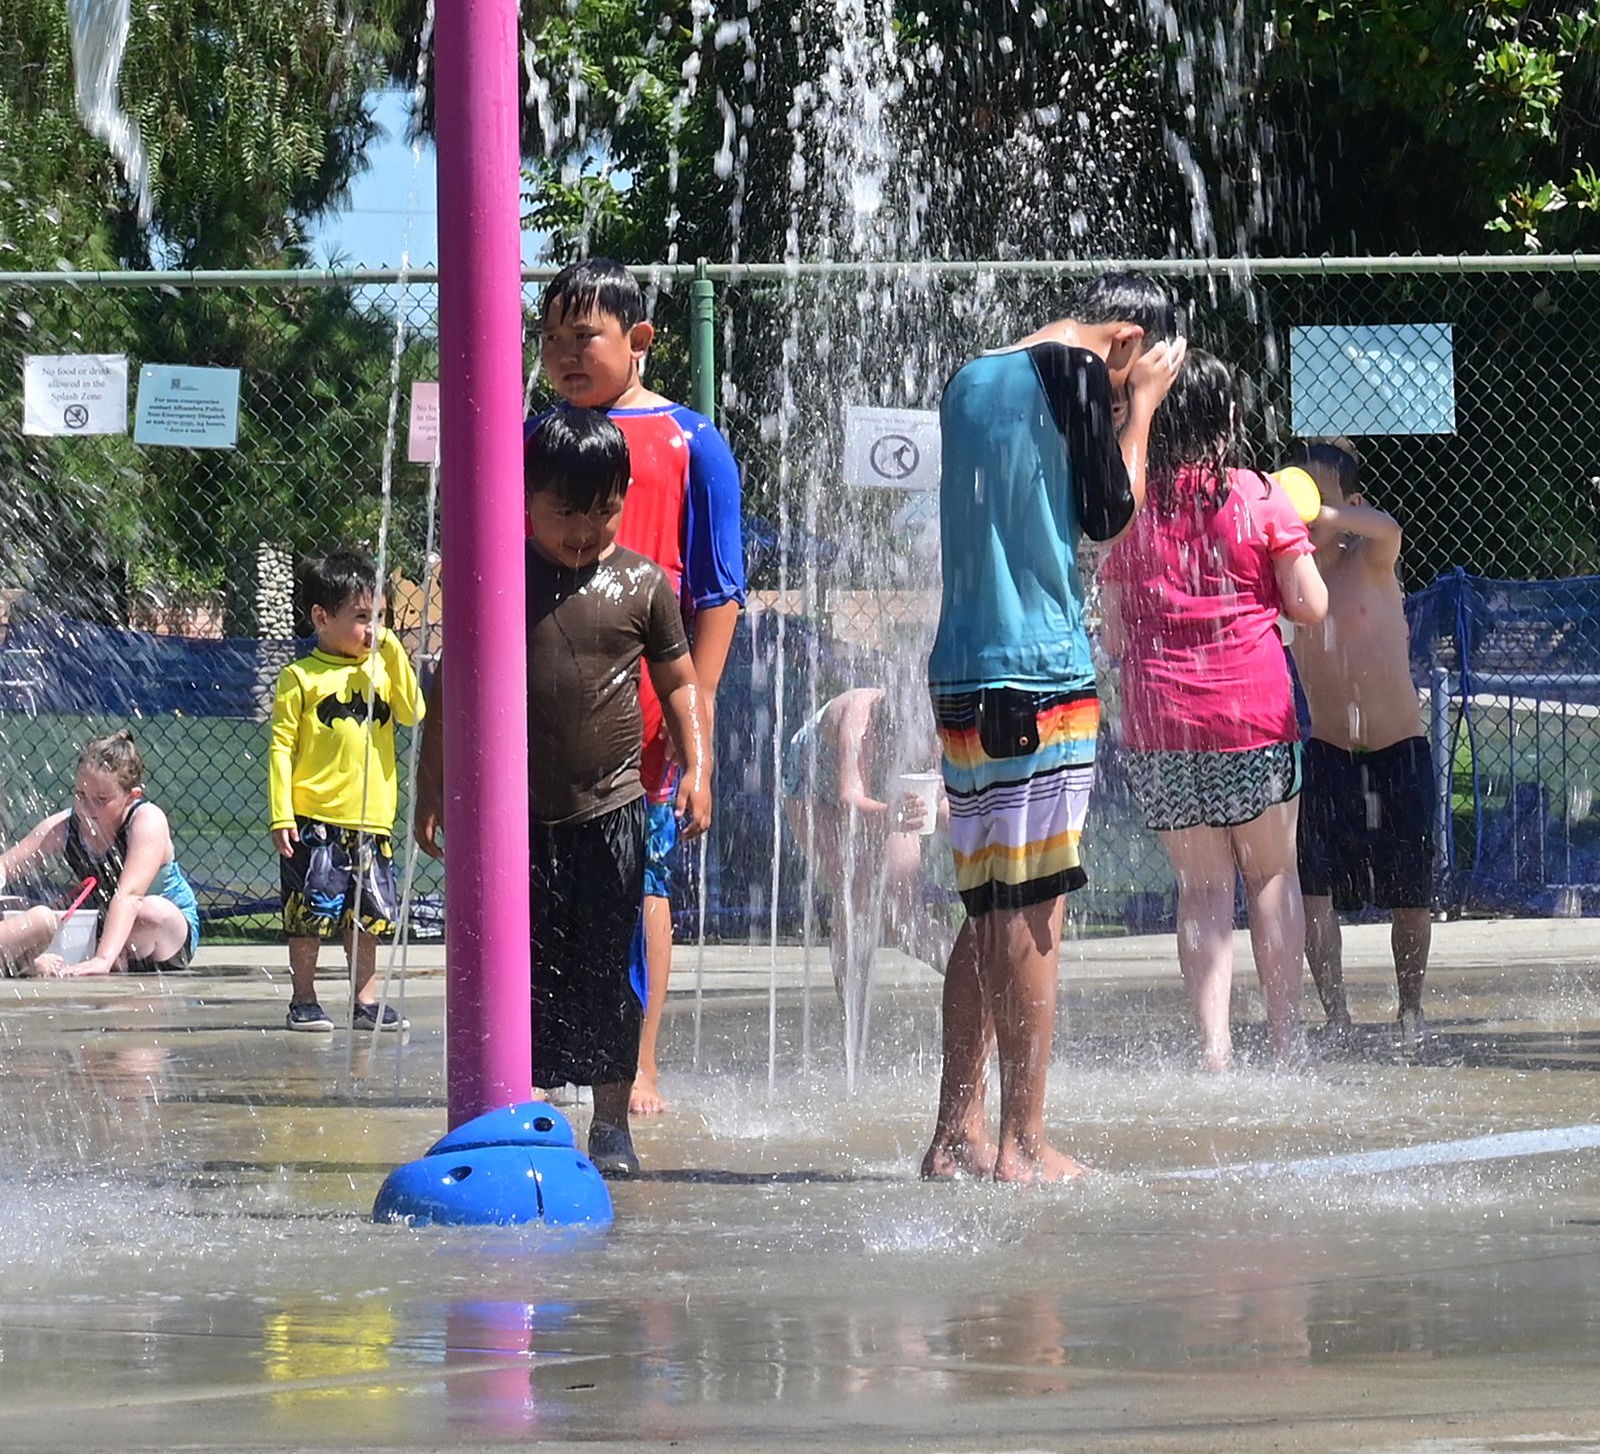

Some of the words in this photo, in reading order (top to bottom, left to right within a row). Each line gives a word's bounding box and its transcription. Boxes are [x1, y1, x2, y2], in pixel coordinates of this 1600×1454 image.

[42, 367, 55, 376] No
[57, 367, 76, 375] food
[89, 367, 111, 375] drink
[47, 379, 80, 388] allowed
[82, 380, 91, 388] in
[93, 379, 106, 388] the
[51, 392, 78, 403] Splash
[81, 392, 102, 401] Zone
